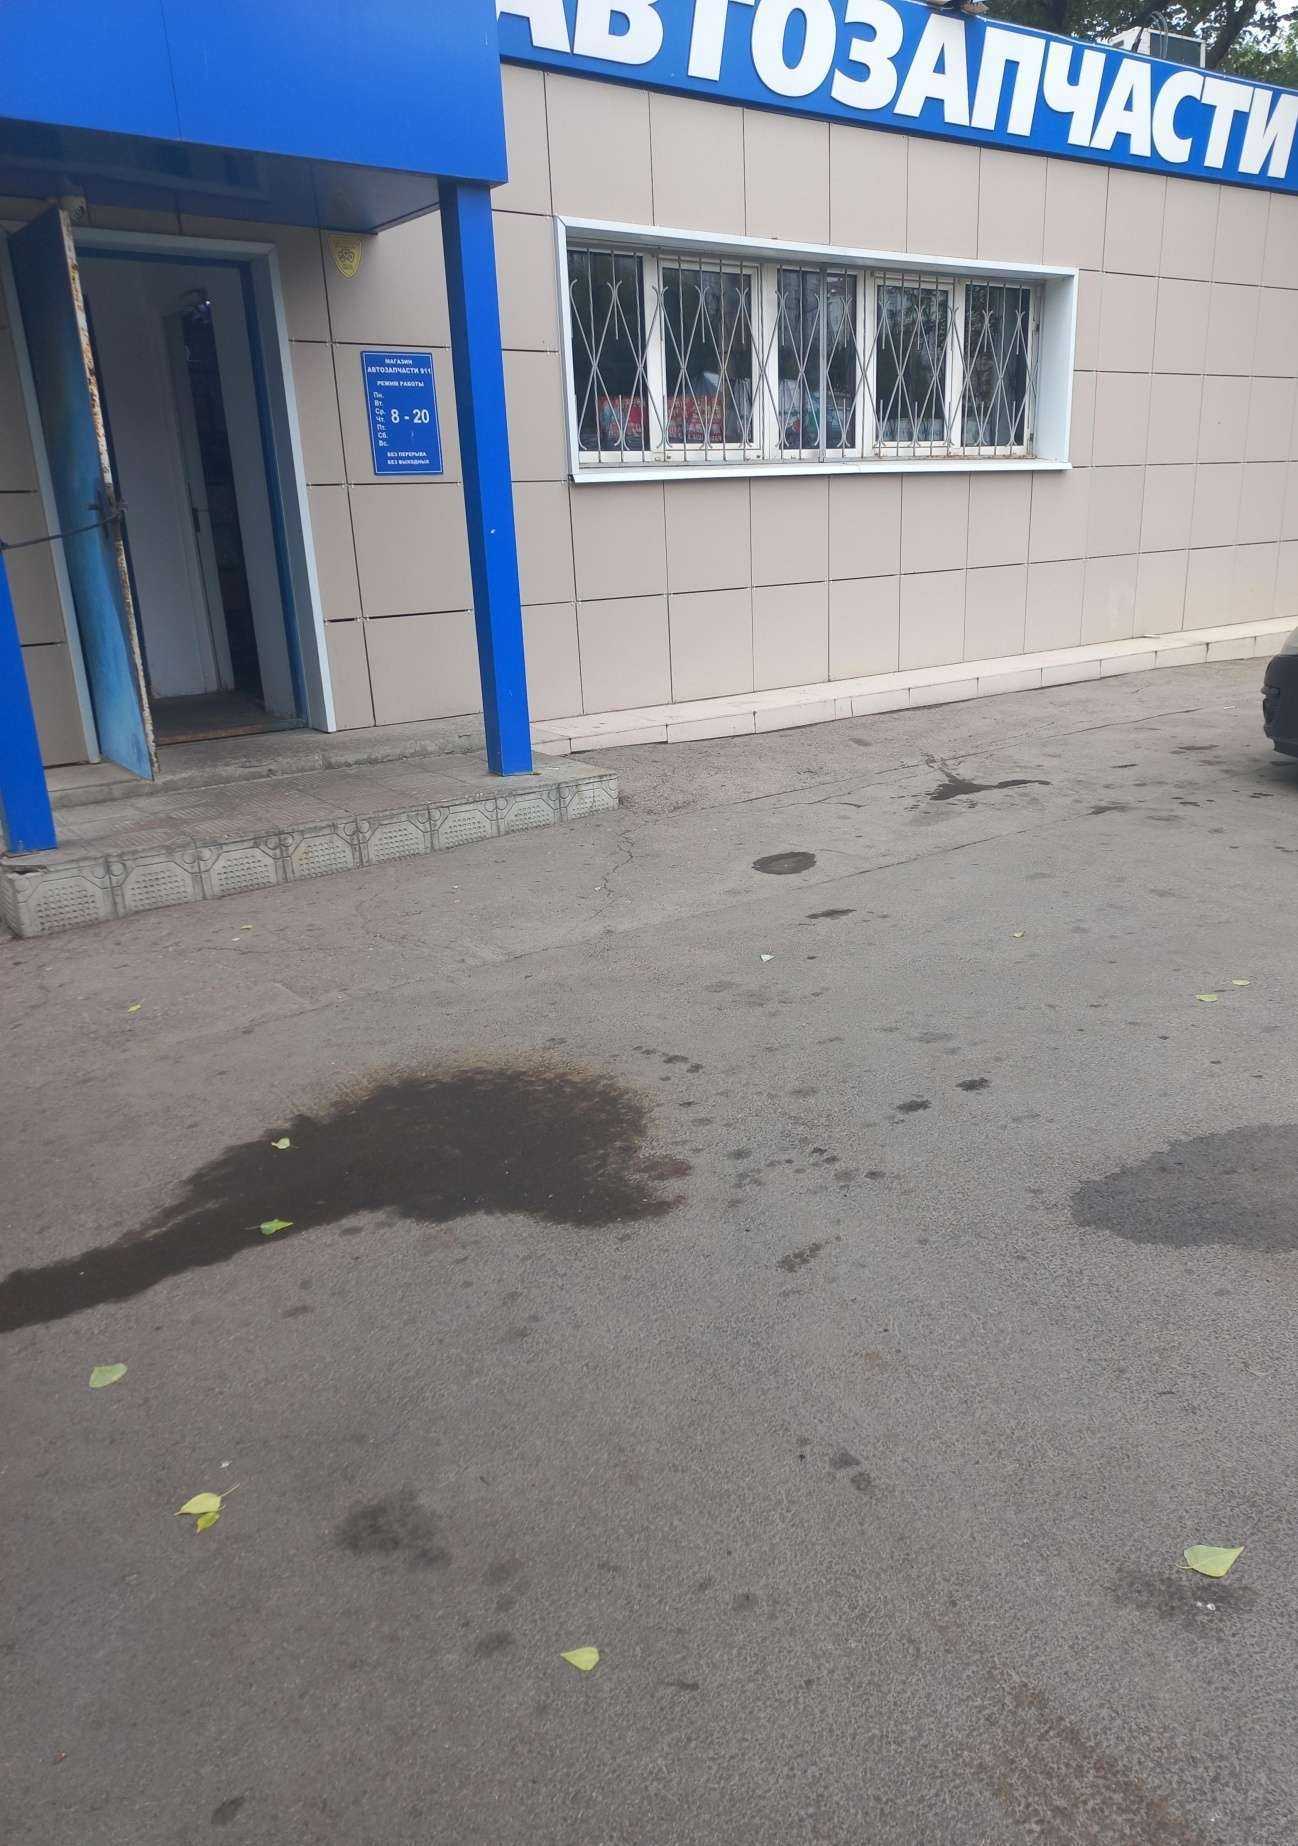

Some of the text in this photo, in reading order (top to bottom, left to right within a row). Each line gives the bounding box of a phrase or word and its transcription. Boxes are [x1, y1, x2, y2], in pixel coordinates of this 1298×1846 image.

[367, 366, 419, 374] АВТОЗАПЧАСТИ
[373, 391, 385, 399] Пн.
[390, 408, 400, 424] 8
[412, 408, 430, 424] 20
